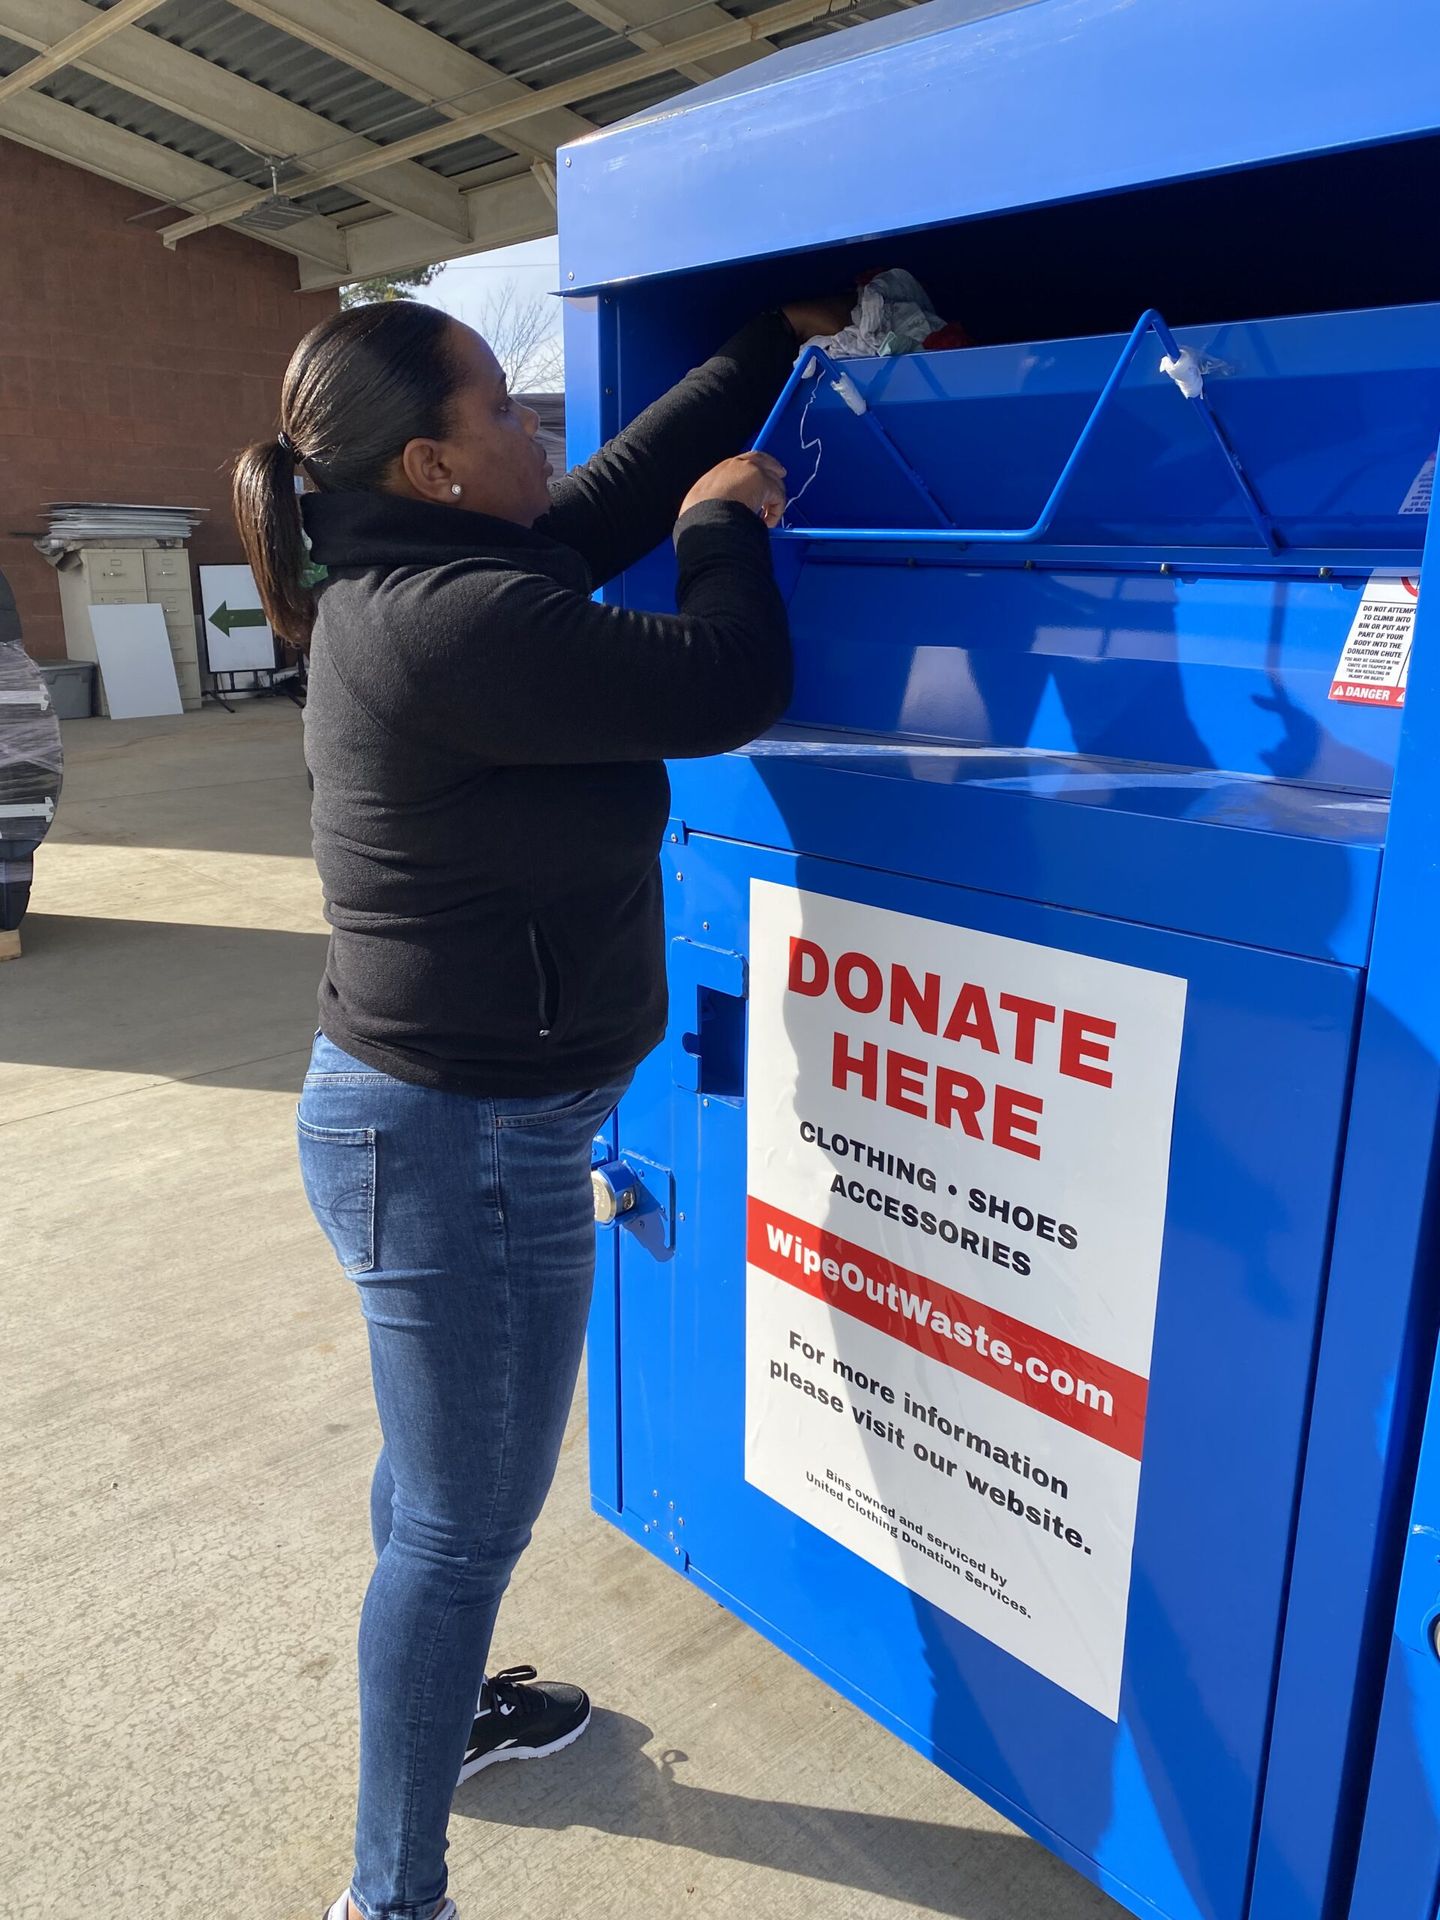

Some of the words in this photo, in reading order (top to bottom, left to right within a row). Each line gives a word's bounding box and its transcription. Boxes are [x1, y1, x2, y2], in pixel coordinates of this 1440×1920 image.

[1345, 686, 1390, 701] DANGER
[1347, 648, 1380, 656] DONATION
[788, 935, 1117, 1089] DONATE
[831, 1031, 1044, 1161] HERE
[799, 1120, 937, 1194] CLOTHING
[968, 1188, 1079, 1250] SHOES
[829, 1174, 1032, 1277] ACCESSORIES
[766, 1223, 1114, 1418] WipeOutWaste.com
[770, 1359, 844, 1414] please
[852, 1405, 905, 1450] visit
[913, 1442, 958, 1477] our
[965, 1470, 1092, 1555] website.
[789, 1331, 825, 1365] For
[833, 1358, 895, 1404] more
[904, 1392, 1068, 1499] information
[806, 1470, 843, 1502] United
[847, 1498, 898, 1539] Clothing
[902, 1531, 960, 1575] Donation
[965, 1570, 1032, 1619] Services.
[826, 1468, 852, 1491] Bins
[855, 1489, 896, 1519] owned
[899, 1515, 923, 1536] and
[927, 1532, 986, 1574] serviced
[991, 1568, 1008, 1587] by
